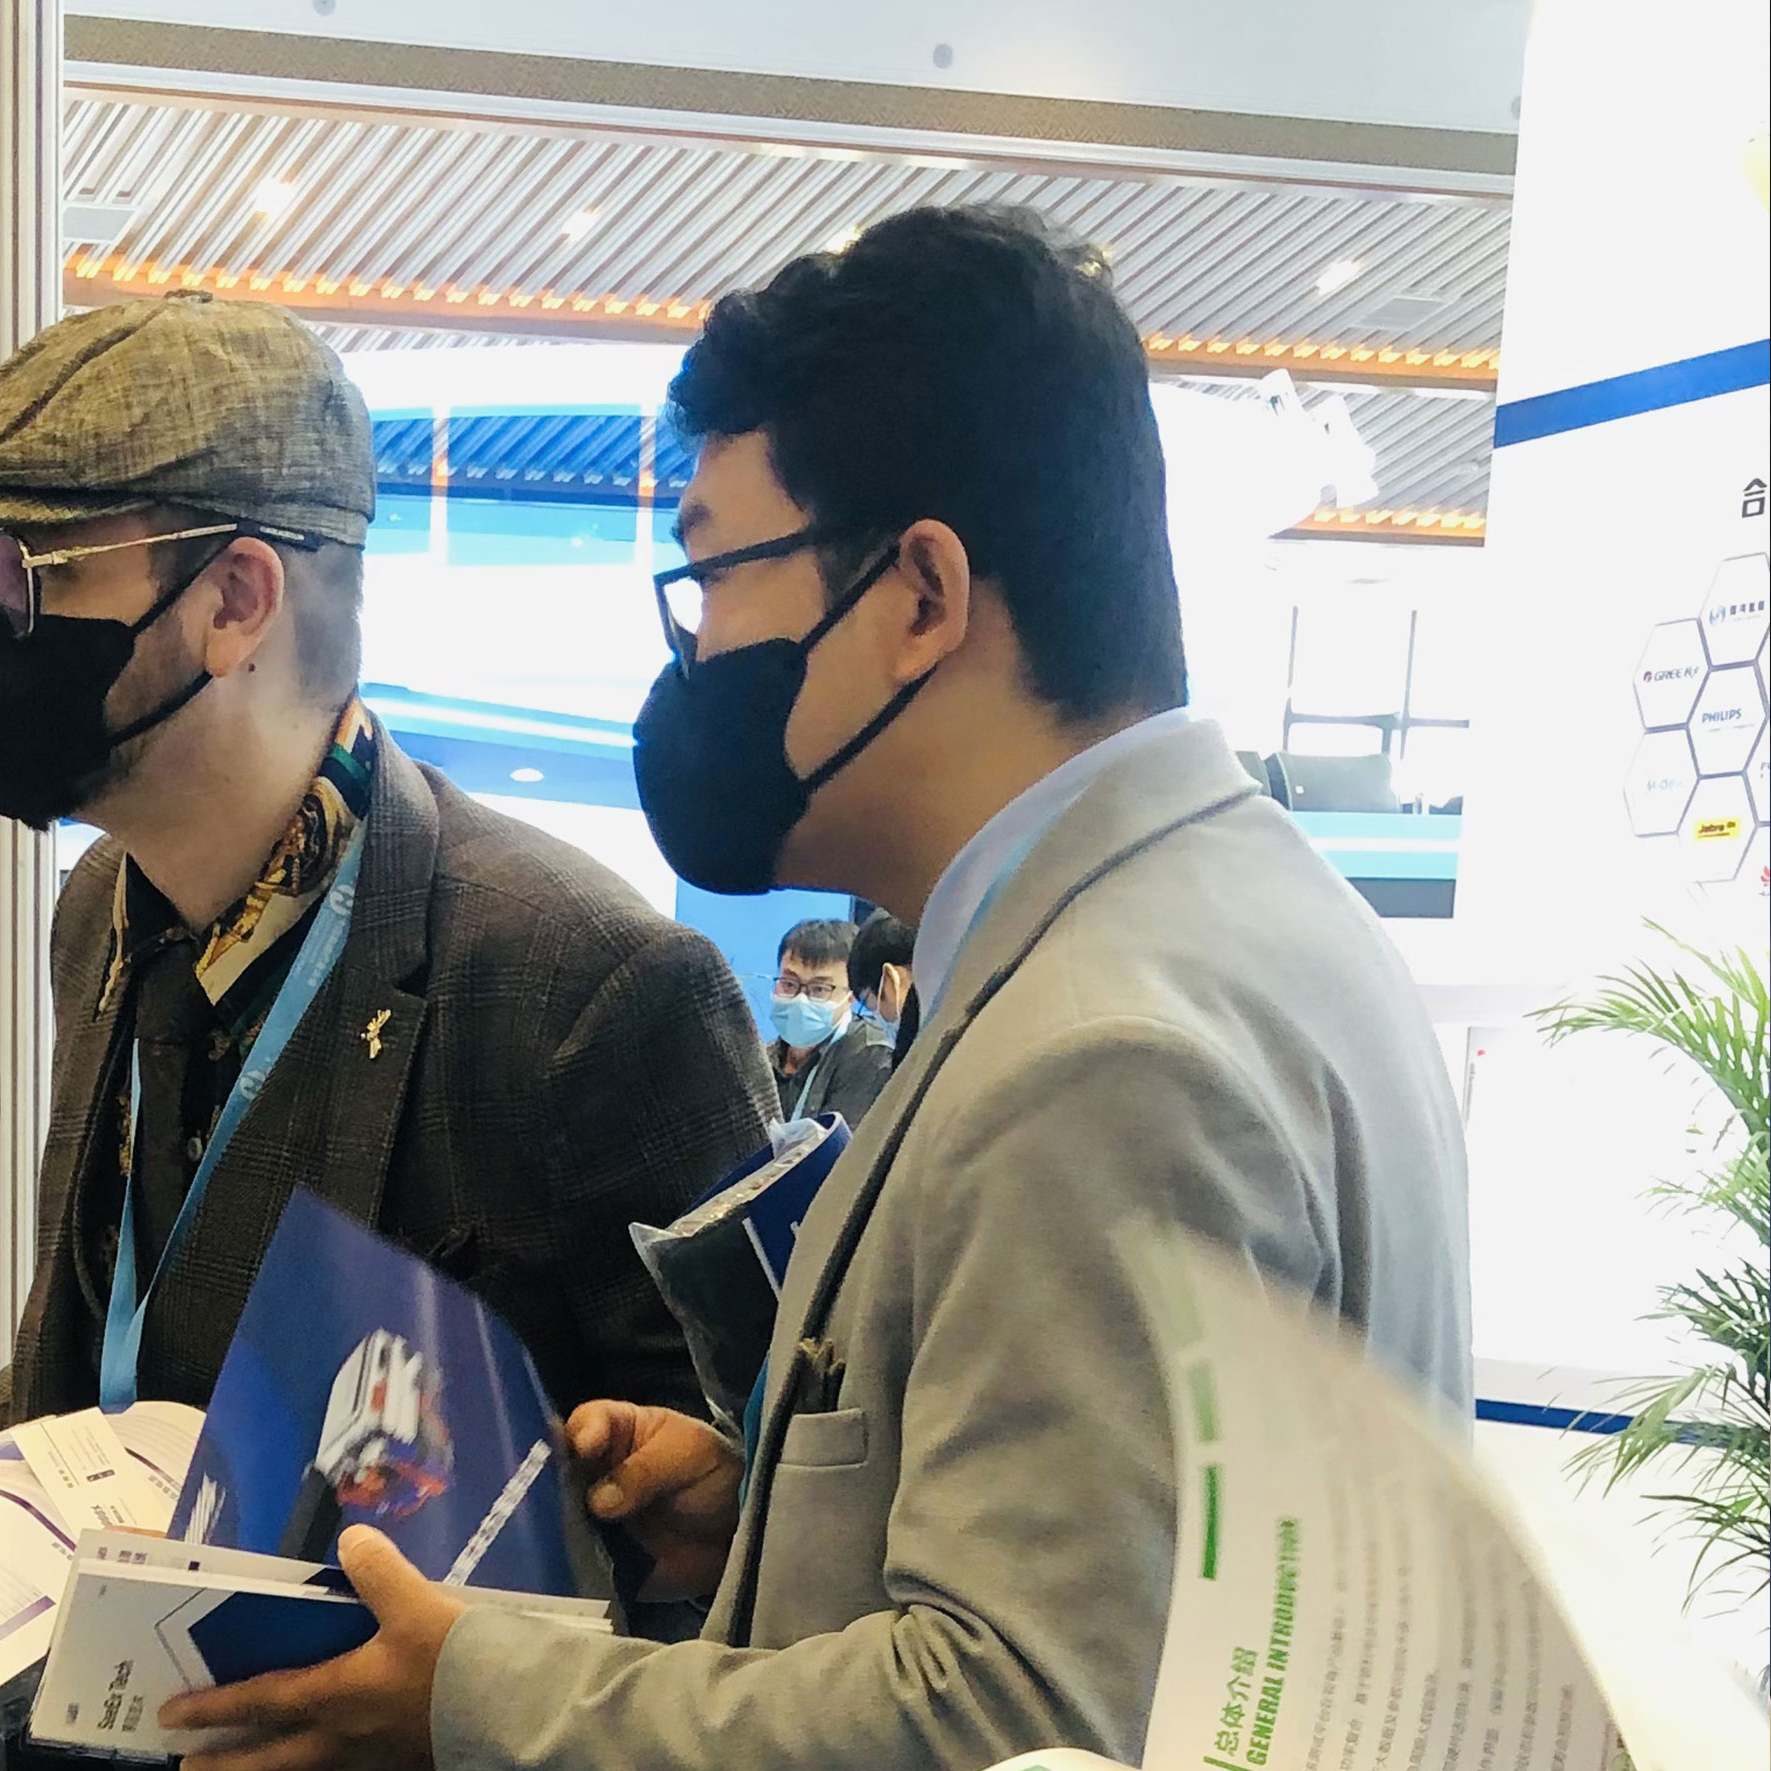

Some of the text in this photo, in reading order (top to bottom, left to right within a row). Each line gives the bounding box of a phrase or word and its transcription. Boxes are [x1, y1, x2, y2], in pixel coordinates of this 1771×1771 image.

[1702, 708, 1742, 723] PHILIPS
[1214, 1647, 1258, 1756] 总体介绍
[1246, 1677, 1284, 1766] GENERAL
